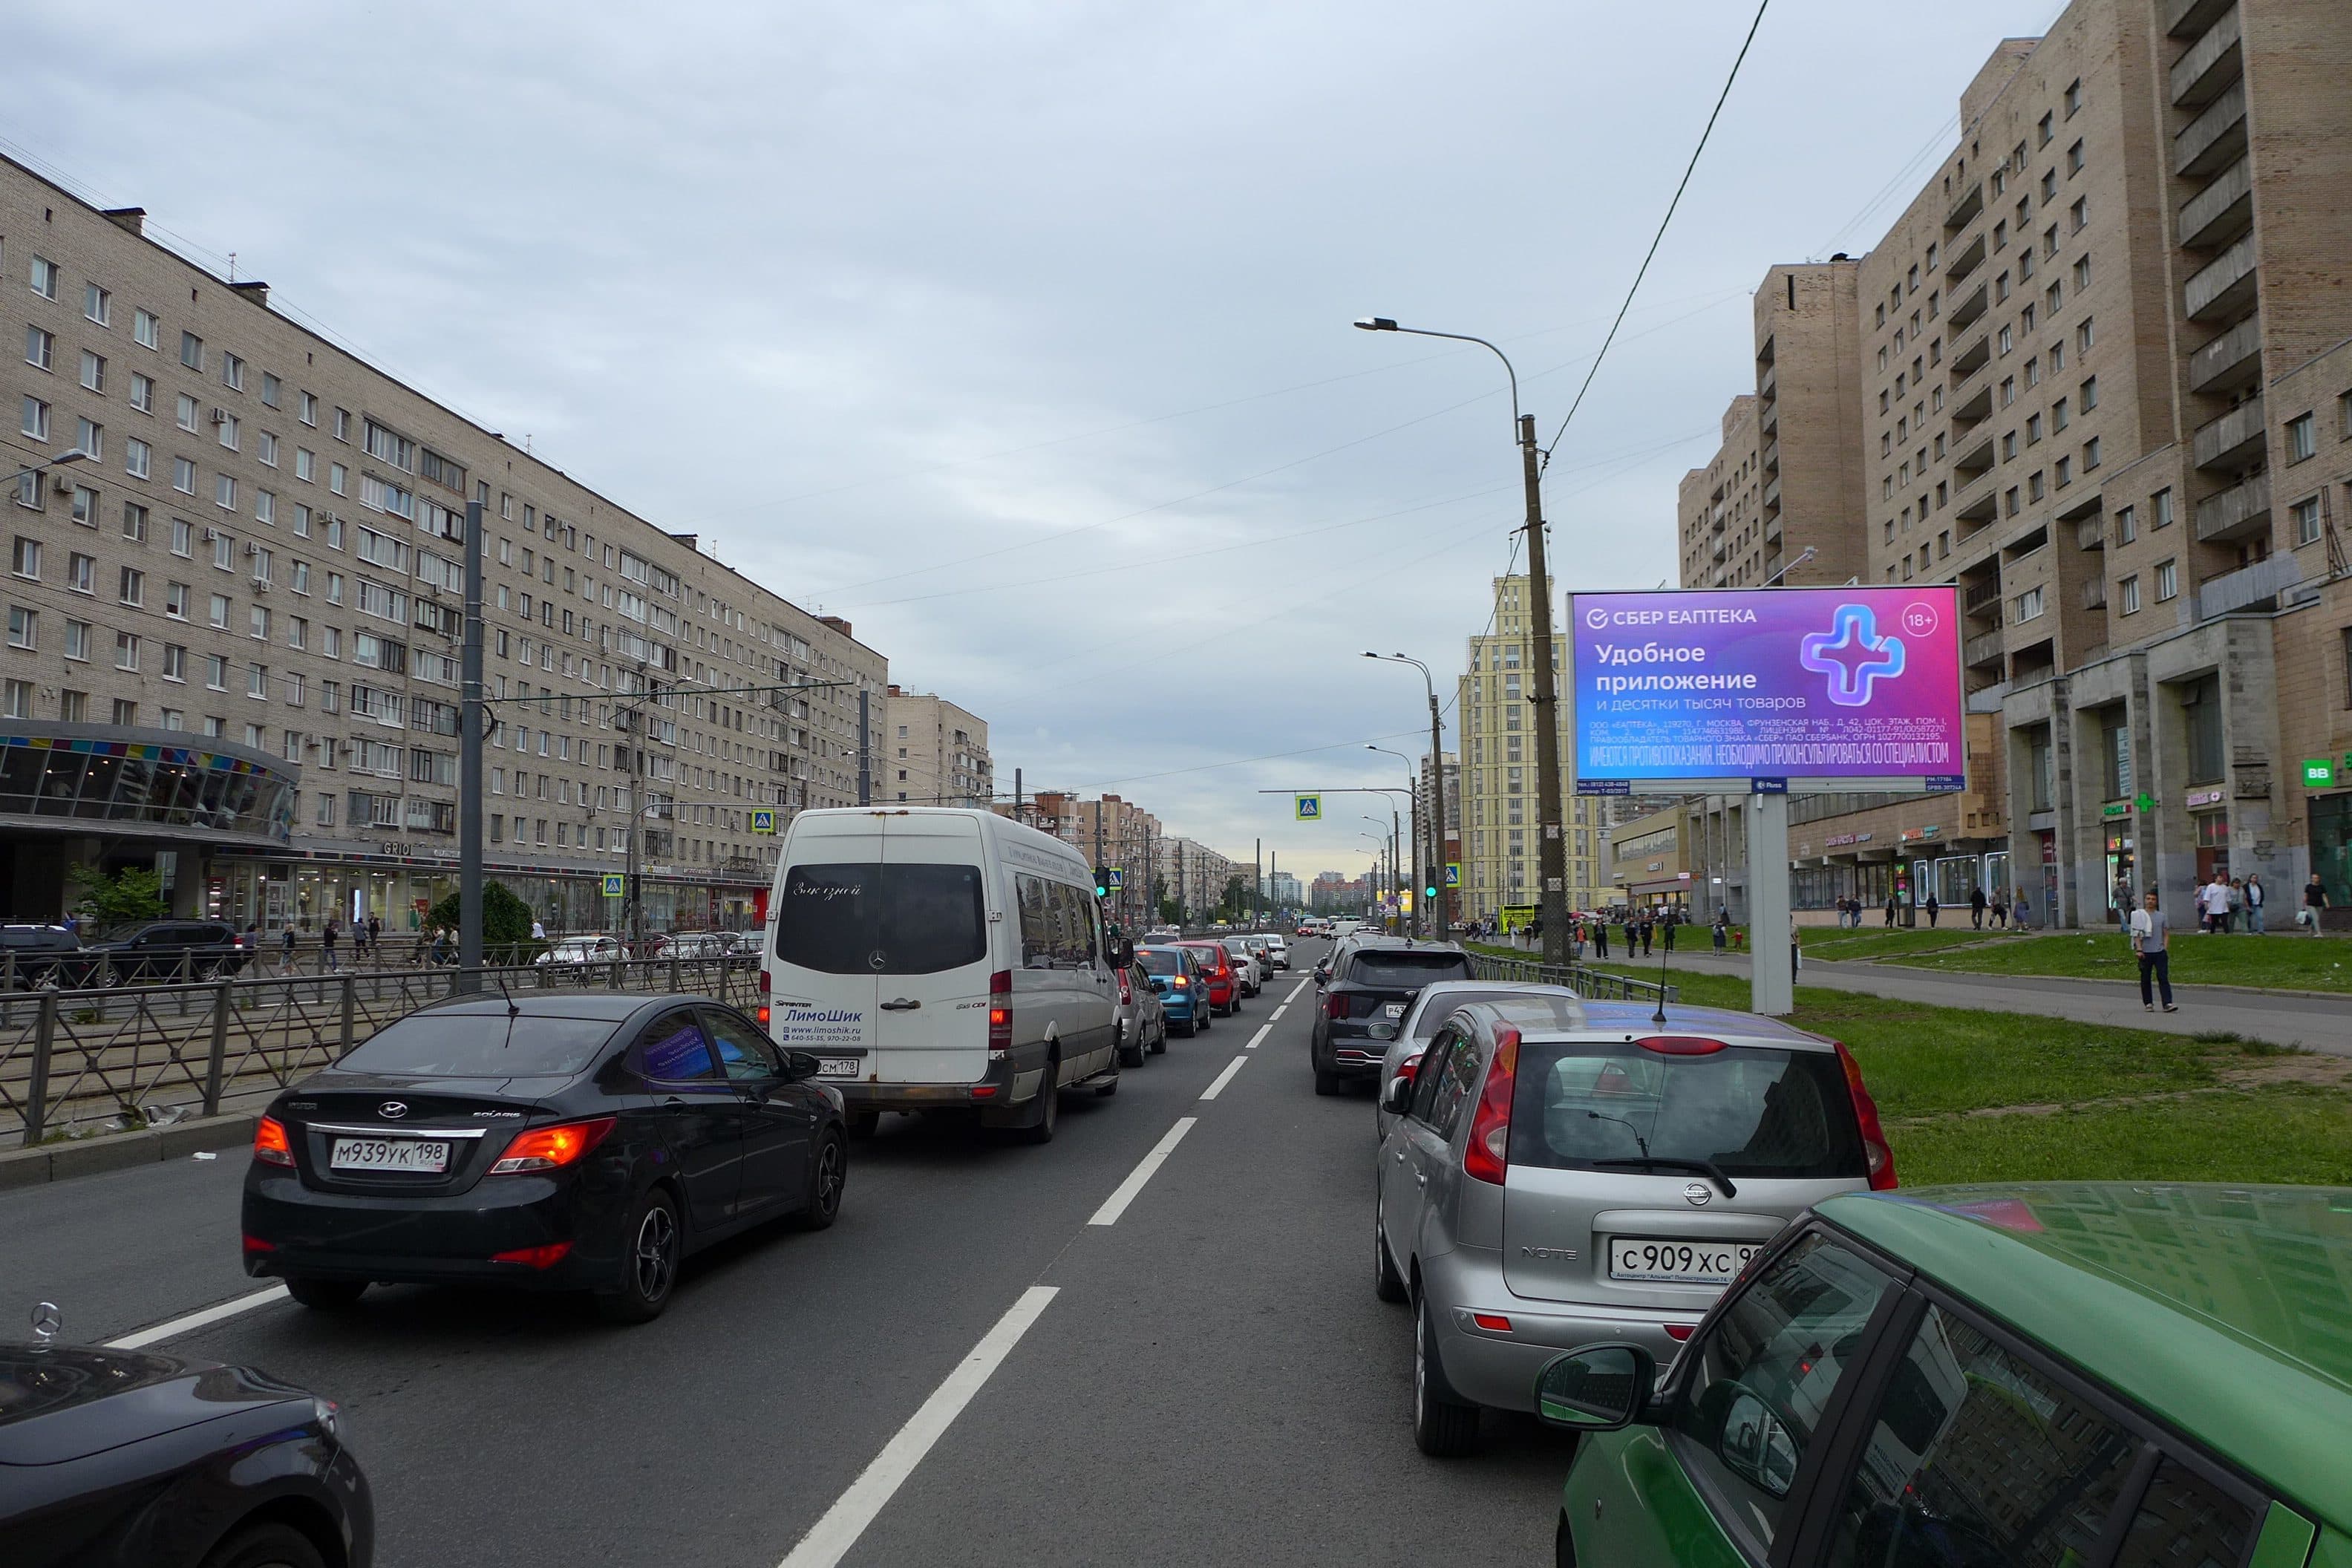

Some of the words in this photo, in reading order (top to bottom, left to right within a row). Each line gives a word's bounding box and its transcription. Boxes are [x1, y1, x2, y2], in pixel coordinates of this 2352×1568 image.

[1613, 611, 1664, 625] СБЕР
[1668, 609, 1757, 624] ЕАПТЕКА
[1908, 614, 1933, 627] 18+
[1595, 642, 1705, 666] Удобное
[1596, 673, 1757, 696] приложение
[1596, 699, 1607, 711] и
[1611, 699, 1679, 713] десятки
[1683, 697, 1732, 709] тысяч
[1737, 696, 1806, 711] товаров
[1590, 735, 1671, 743] ПРАВООБЛАДАТЕЛЬ
[1806, 734, 1852, 742] СБЕРБАНК,
[1590, 745, 1628, 766] ИМЕЮТСЯ
[1716, 743, 1770, 769] НЕОБХОДИМО
[1772, 742, 1872, 765] ПРОКОНСУЛЬТИРОВАТЬСЯ
[1872, 742, 1883, 764] СО
[1884, 742, 1950, 768] СПЕЦИАЛИСТОМ
[785, 1010, 863, 1022] ЛимоШик
[791, 1026, 861, 1034] www.limoshik.ru
[839, 1061, 855, 1070] 178
[416, 1143, 442, 1160] 198
[1521, 1247, 1578, 1260] NOTE
[1623, 1245, 1731, 1273] С909ХС
[1740, 1247, 1760, 1267] 9
